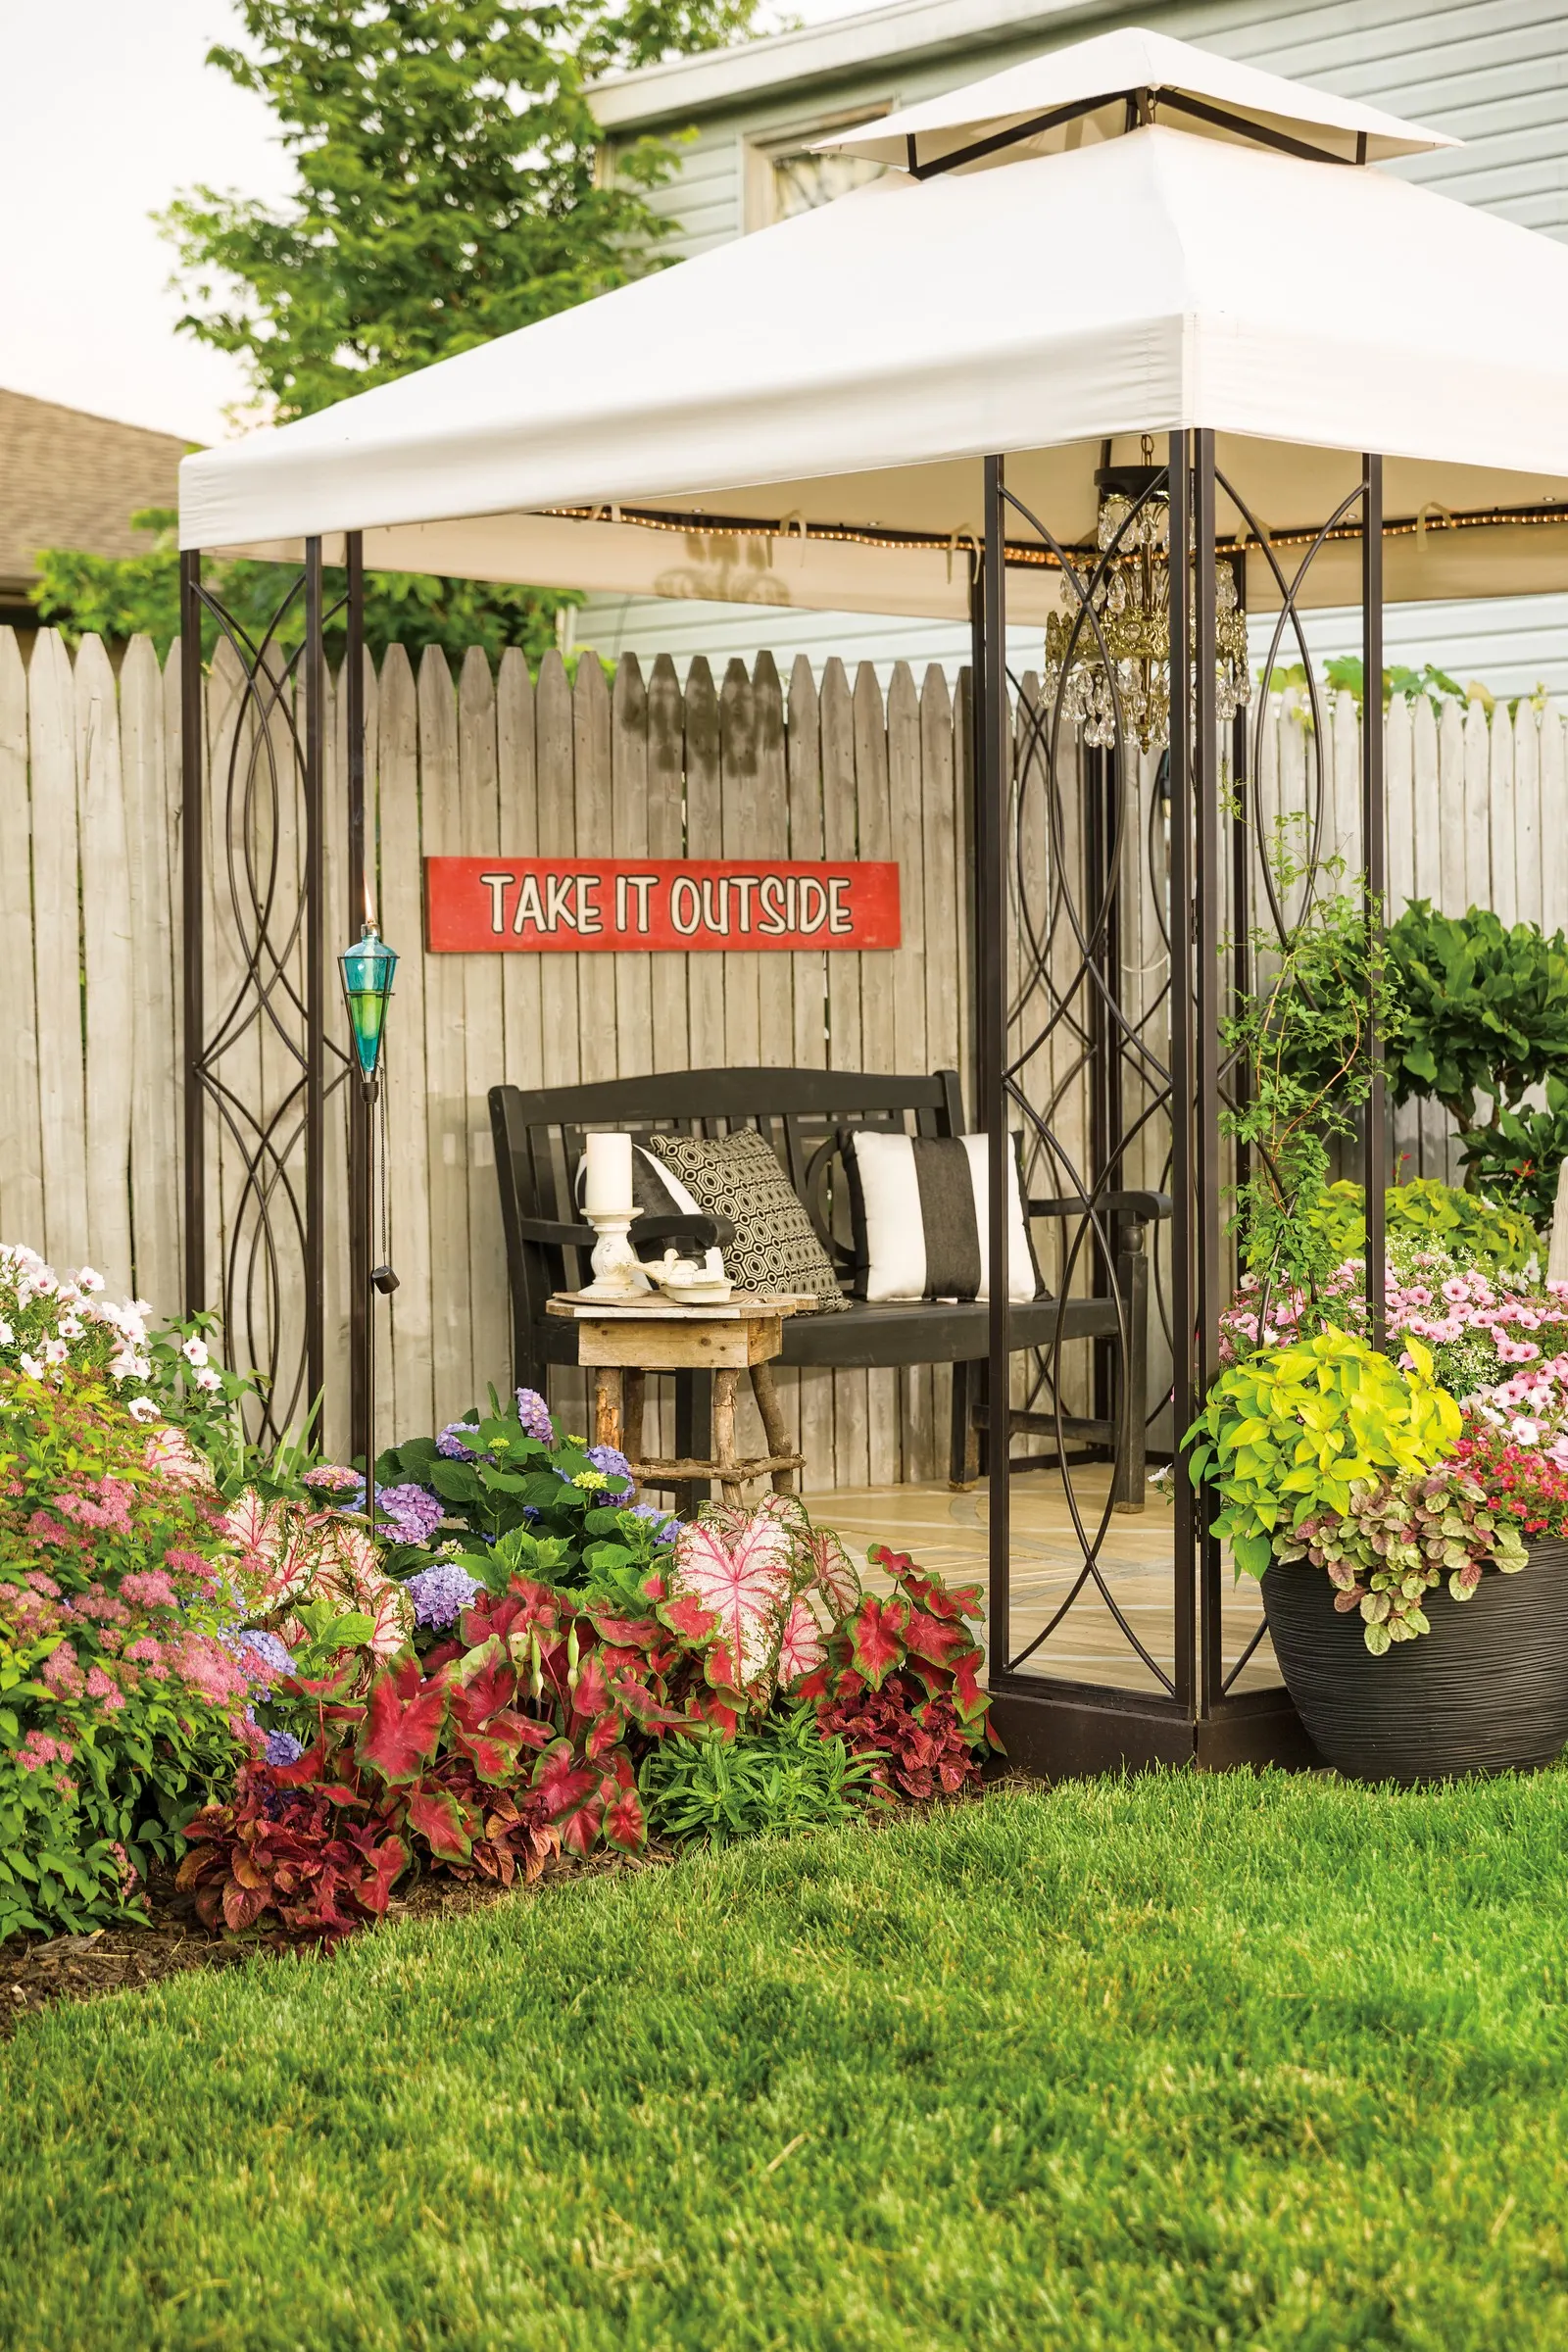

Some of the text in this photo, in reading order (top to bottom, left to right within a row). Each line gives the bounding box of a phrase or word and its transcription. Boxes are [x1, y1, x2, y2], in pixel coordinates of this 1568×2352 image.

[480, 873, 854, 936] TAKE IT OUTSIDE
